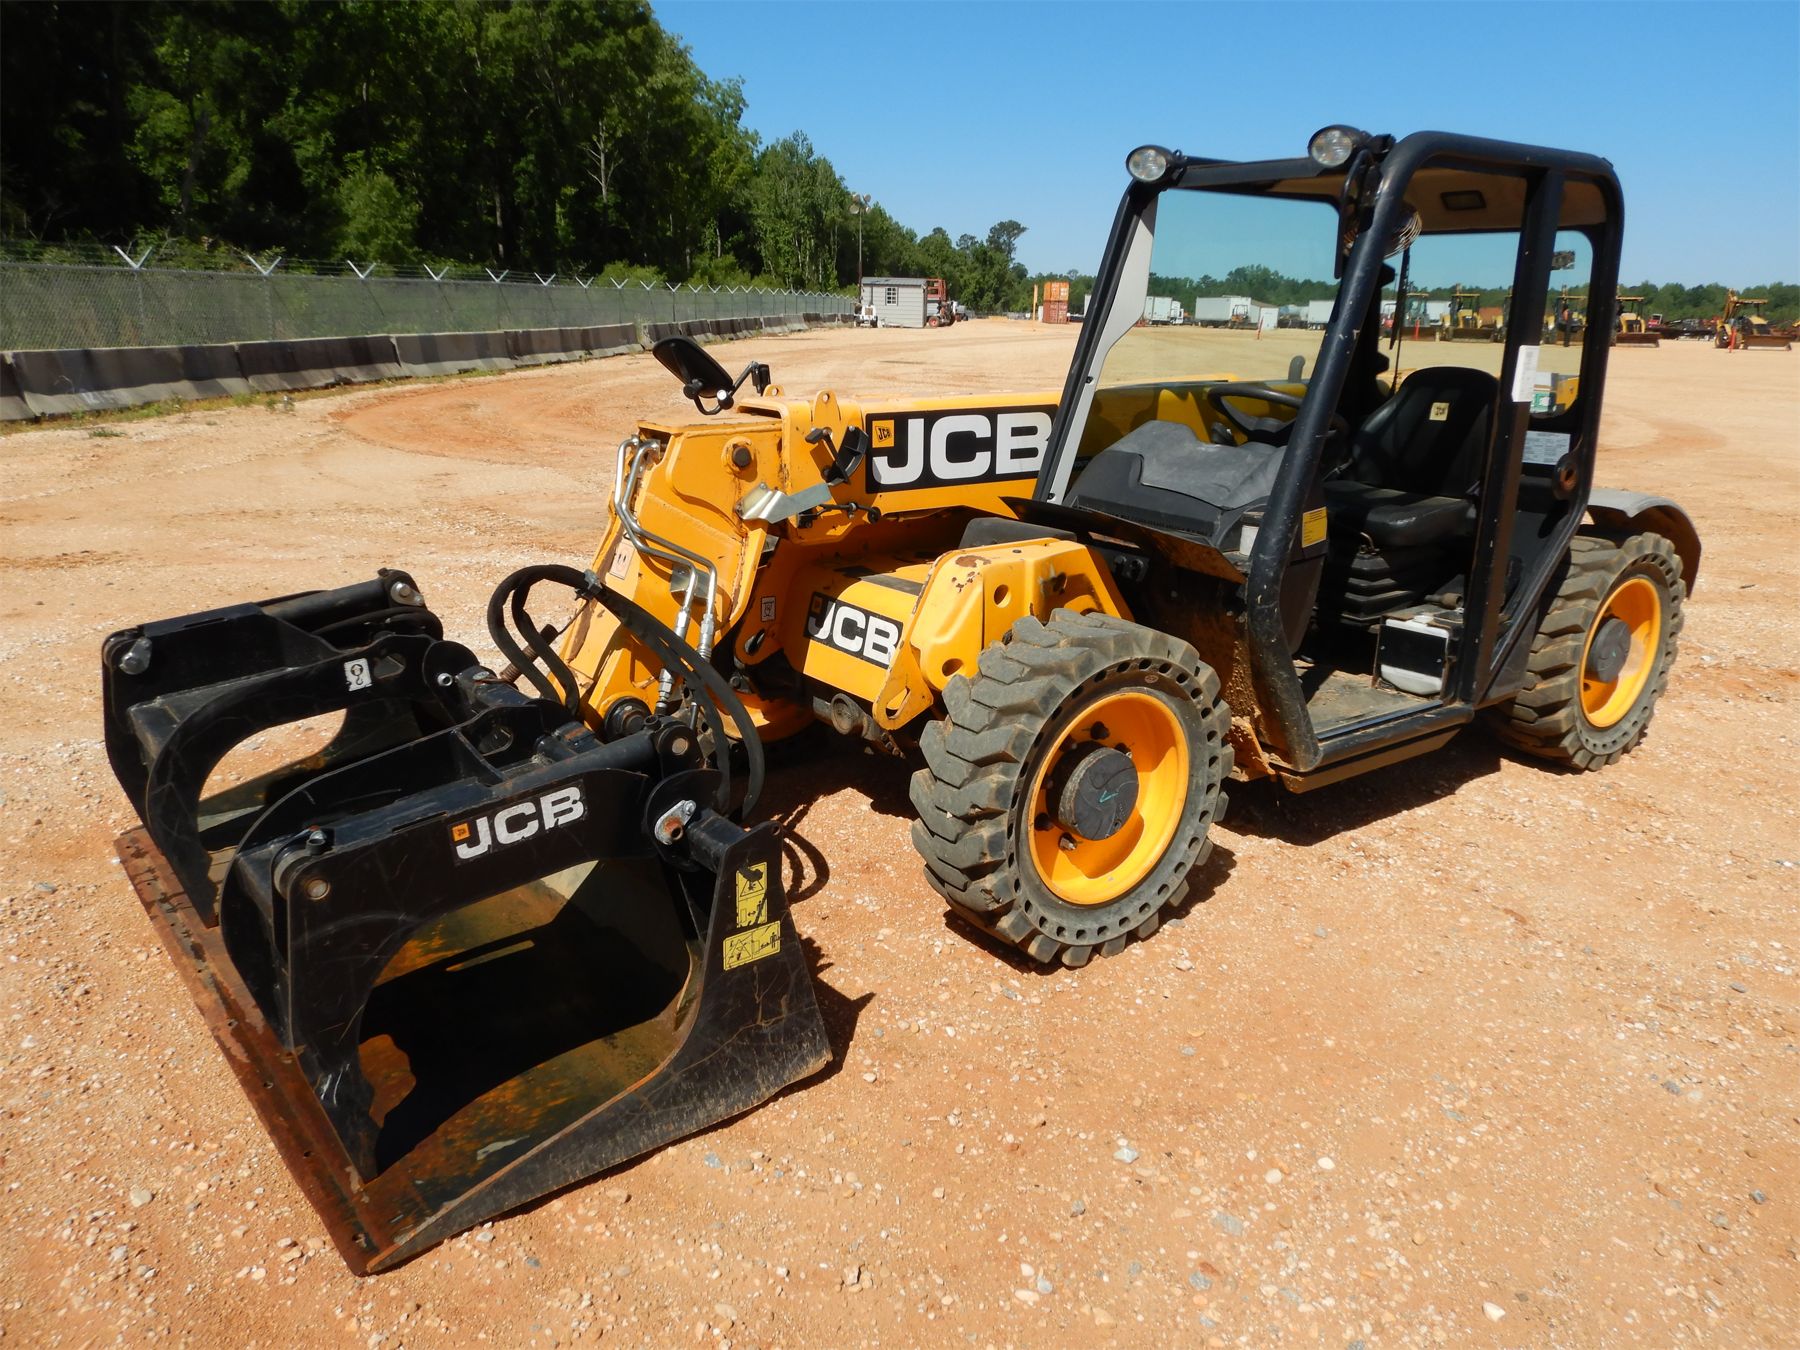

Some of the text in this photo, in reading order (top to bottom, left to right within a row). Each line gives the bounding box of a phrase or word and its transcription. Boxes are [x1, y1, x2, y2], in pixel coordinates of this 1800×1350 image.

[872, 411, 1053, 484] JCB
[807, 600, 899, 665] JCB
[456, 786, 584, 859] JCB
